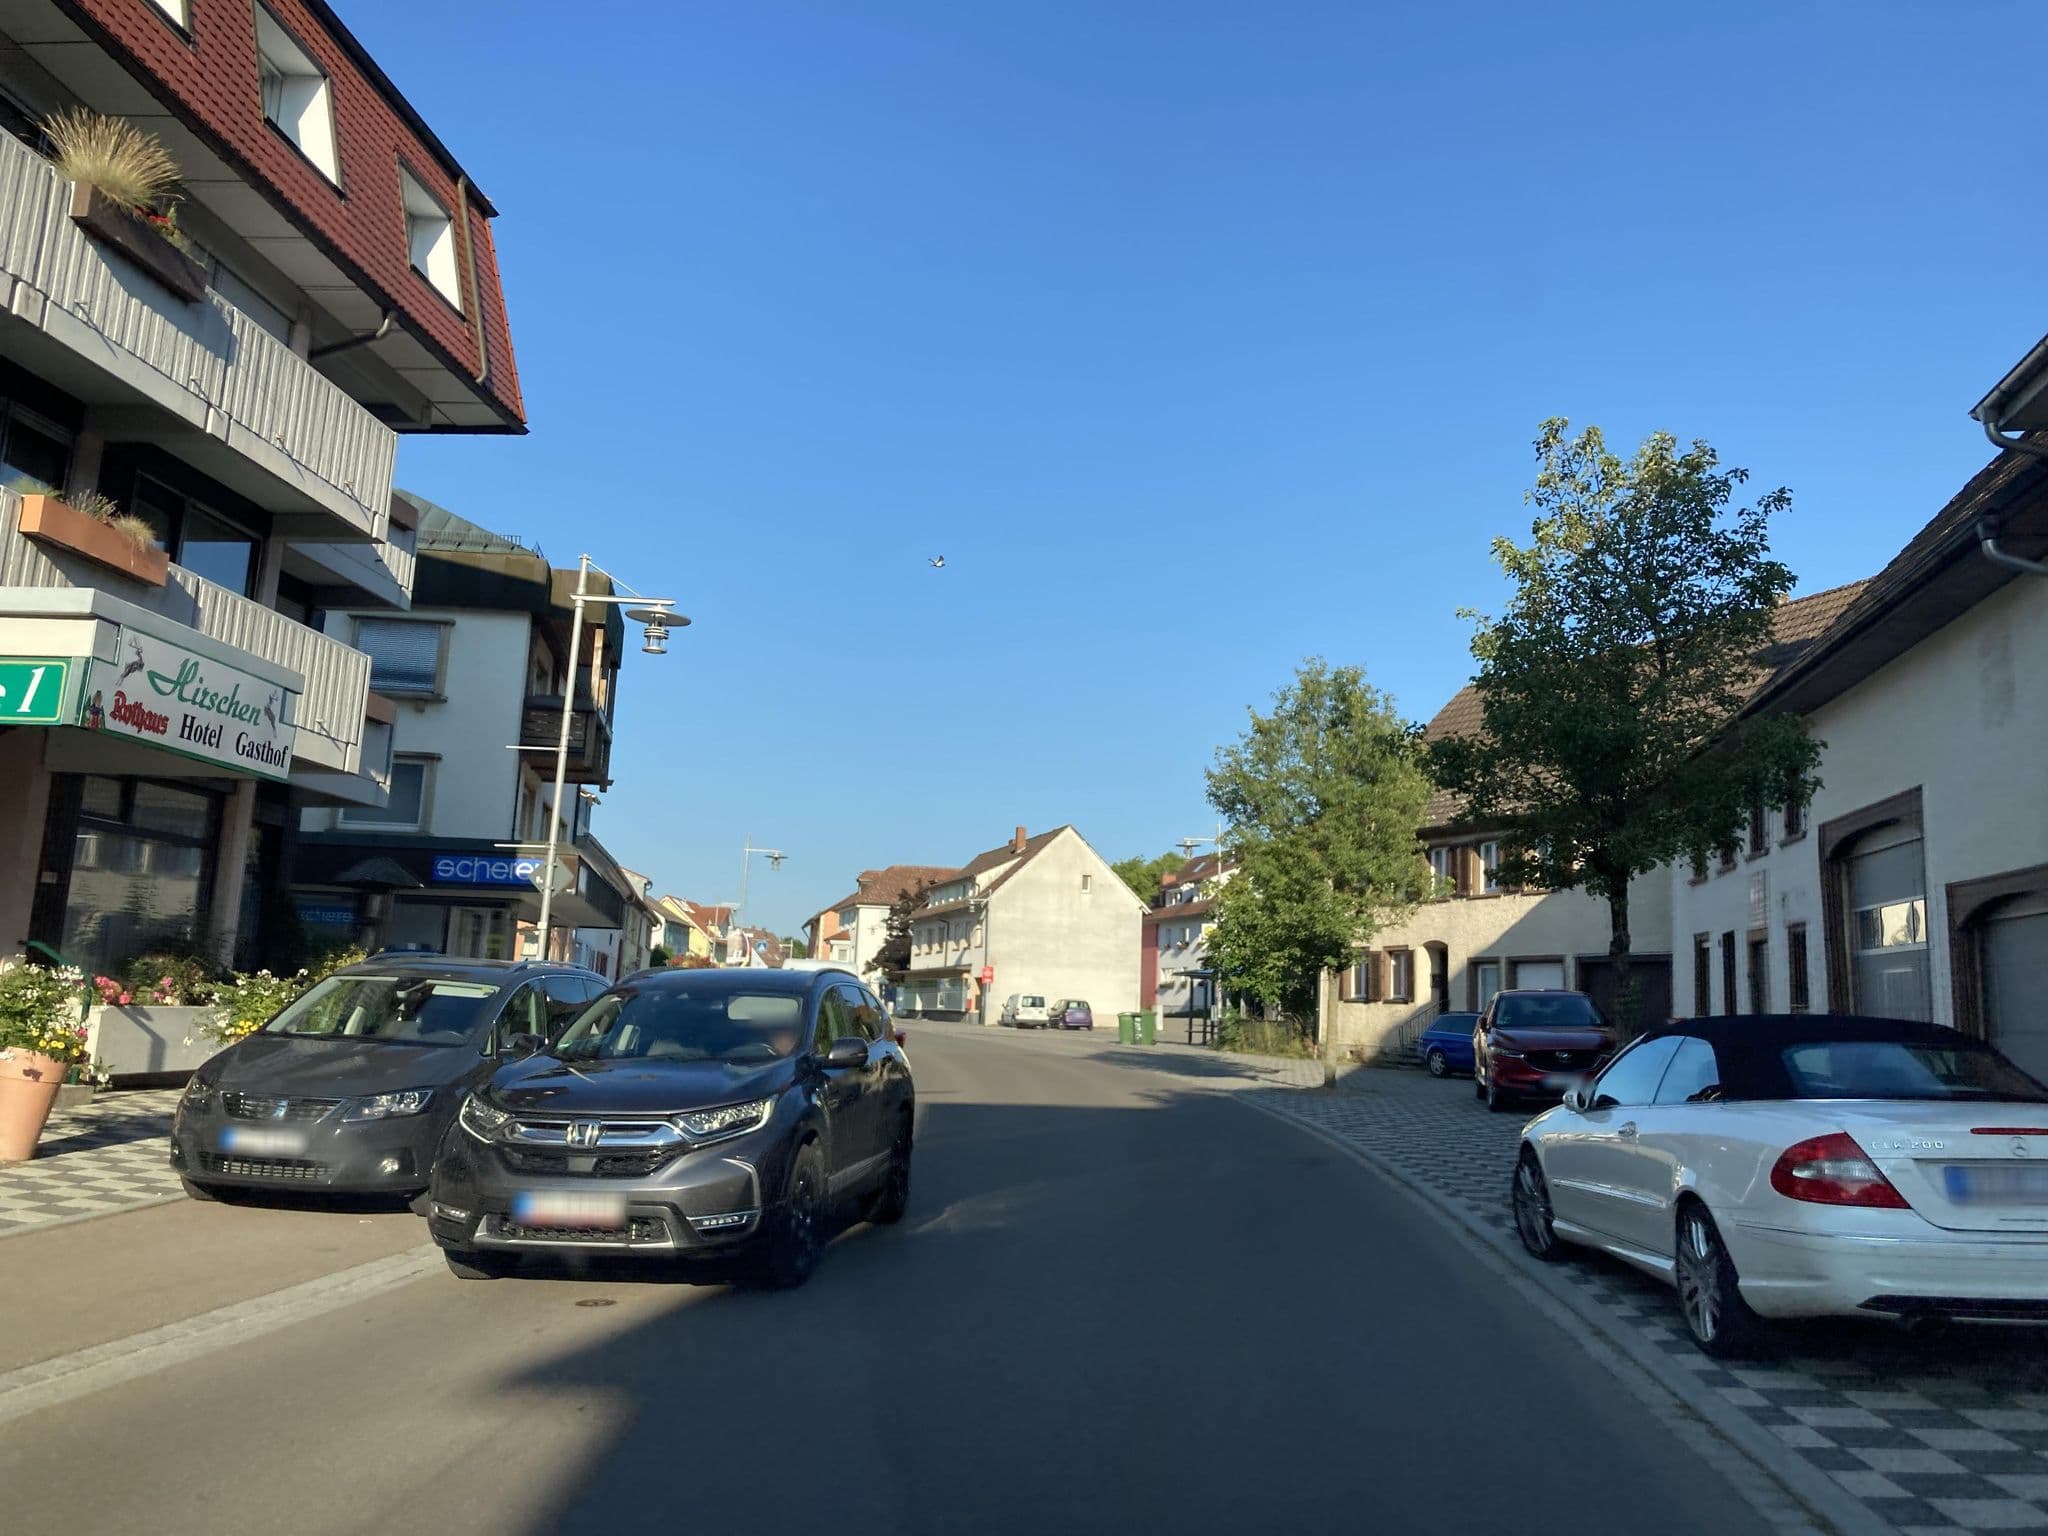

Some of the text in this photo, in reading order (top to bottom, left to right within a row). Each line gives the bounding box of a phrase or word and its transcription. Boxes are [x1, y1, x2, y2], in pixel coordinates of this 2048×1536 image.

[16, 666, 46, 713] 1
[147, 658, 262, 727] Hirschen
[109, 690, 170, 736] Rothaus
[178, 713, 289, 768] Hotel Gasthof
[437, 857, 540, 882] schere
[1911, 1140, 1945, 1150] 200
